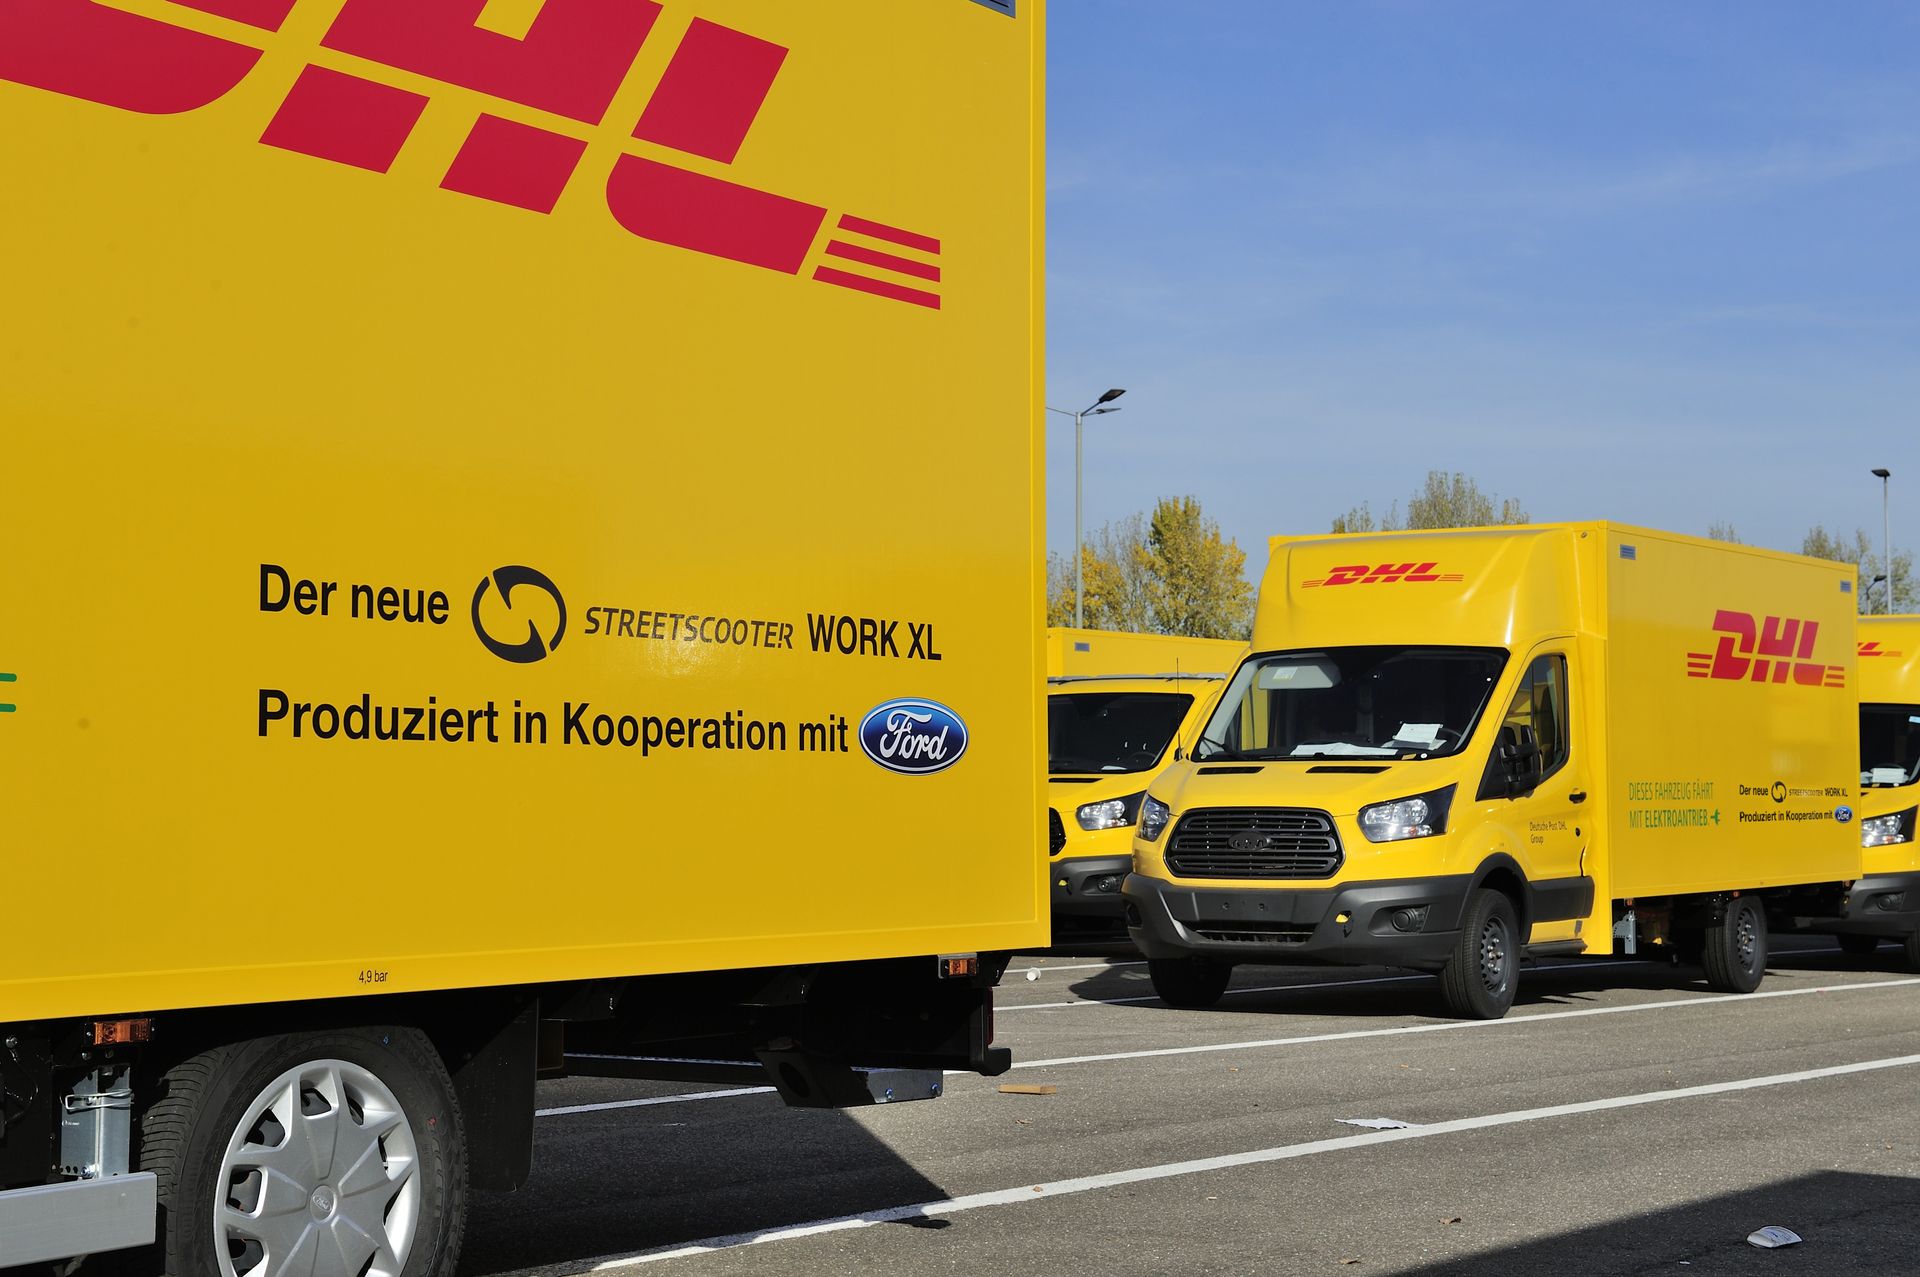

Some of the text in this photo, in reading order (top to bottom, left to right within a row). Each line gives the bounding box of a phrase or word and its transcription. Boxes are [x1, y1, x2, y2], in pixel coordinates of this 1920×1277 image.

[1322, 563, 1441, 587] DHL
[260, 563, 942, 661] Der neue STREETSCOOTER WORK XL
[1711, 609, 1826, 687] DHL
[258, 688, 950, 761] Produziert in Kooperation mit Ford
[1629, 782, 1653, 800] DIESES
[1655, 782, 1691, 800] FAHRZEUG
[1739, 784, 1751, 796] Der
[1753, 787, 1769, 796] neue
[1824, 788, 1841, 797] WORK
[1630, 809, 1643, 828] MIT
[1739, 811, 1777, 822] Produziert
[1778, 811, 1785, 821] in
[1786, 810, 1823, 823] Kooperation
[1824, 810, 1834, 820] mit
[359, 969, 388, 984] 4,9 bar
